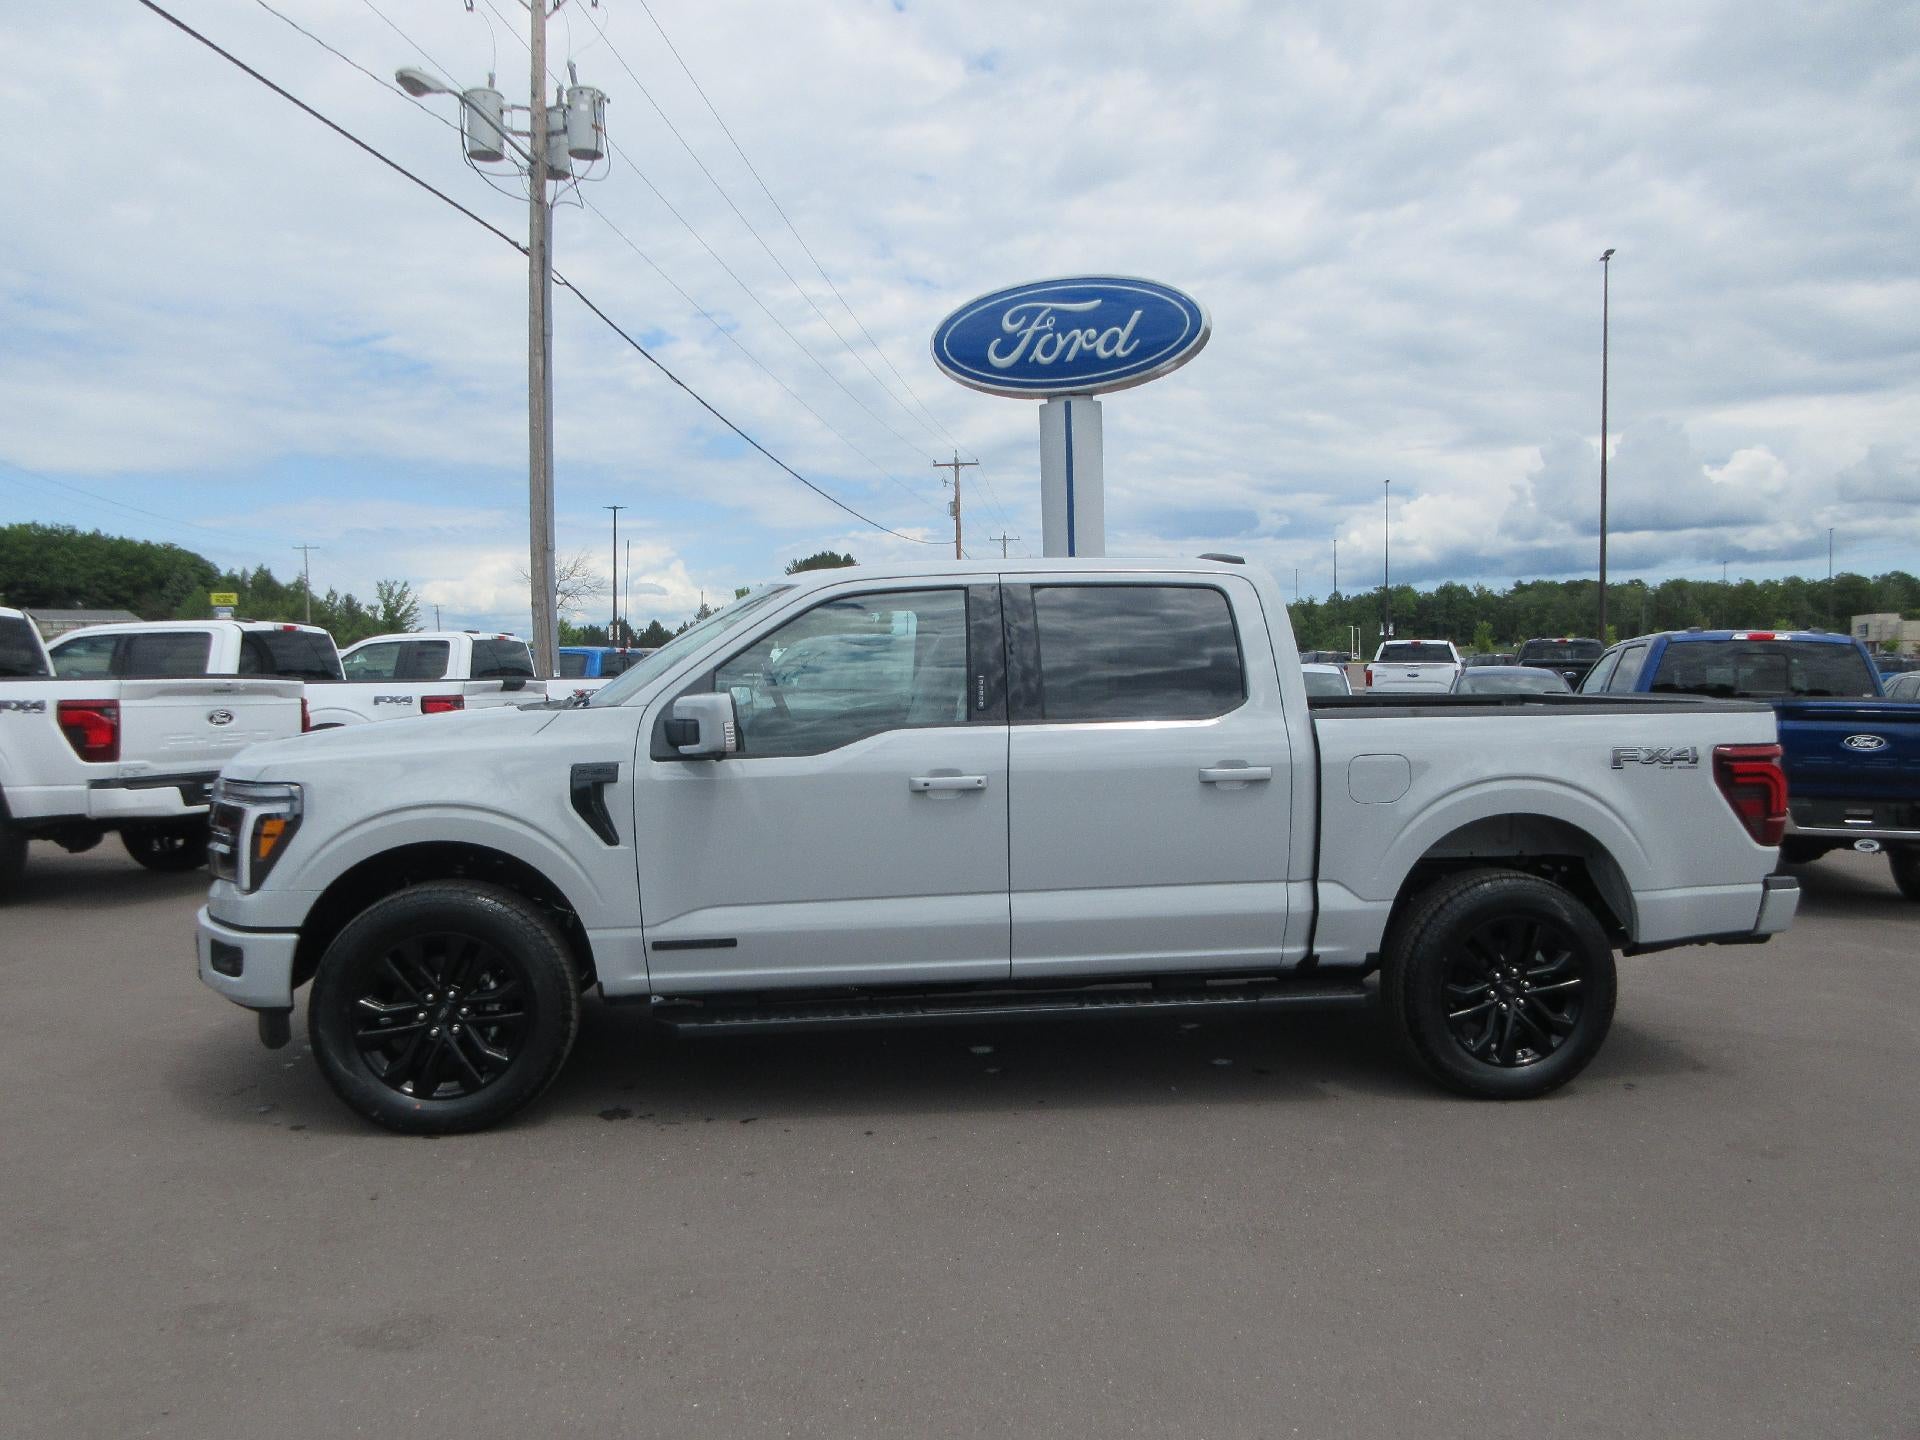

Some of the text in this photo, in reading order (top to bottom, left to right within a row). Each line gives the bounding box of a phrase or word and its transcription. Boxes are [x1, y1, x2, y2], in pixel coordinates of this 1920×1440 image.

[988, 299, 1143, 369] Ford
[373, 695, 413, 706] FX4
[1850, 736, 1878, 747] Ford
[1611, 746, 1698, 770] FX4
